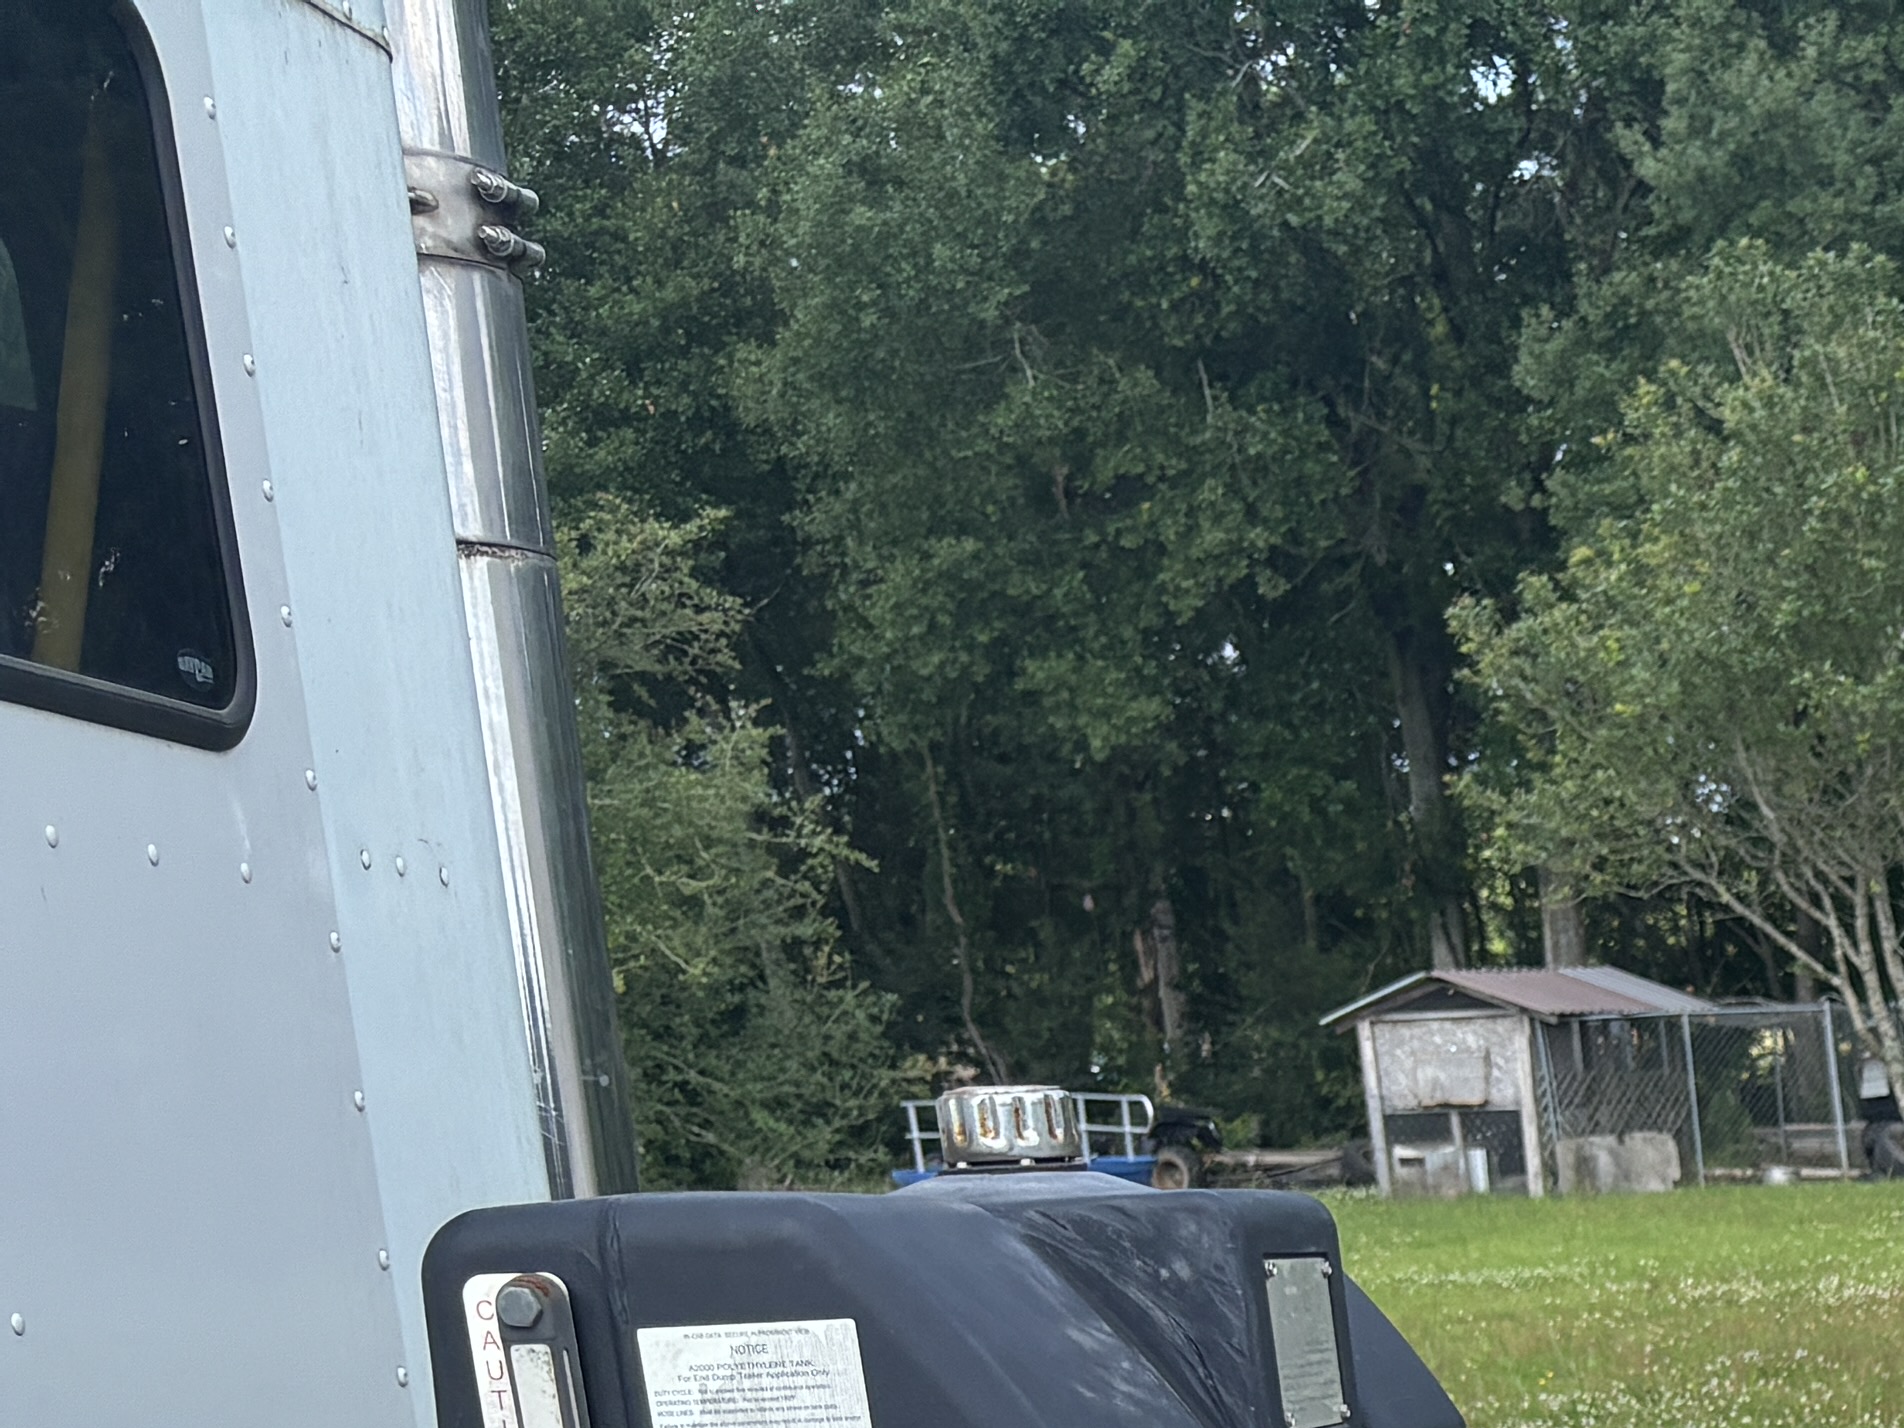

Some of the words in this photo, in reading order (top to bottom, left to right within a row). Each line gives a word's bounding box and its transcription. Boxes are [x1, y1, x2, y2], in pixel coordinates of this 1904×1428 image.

[730, 1343, 769, 1356] NOTICE
[716, 1360, 787, 1371] POLYETHYLENE
[677, 1374, 691, 1382] For
[711, 1373, 736, 1382] Dump
[737, 1371, 763, 1380] Trailer
[766, 1369, 809, 1379] Application
[810, 1368, 830, 1378] Only
